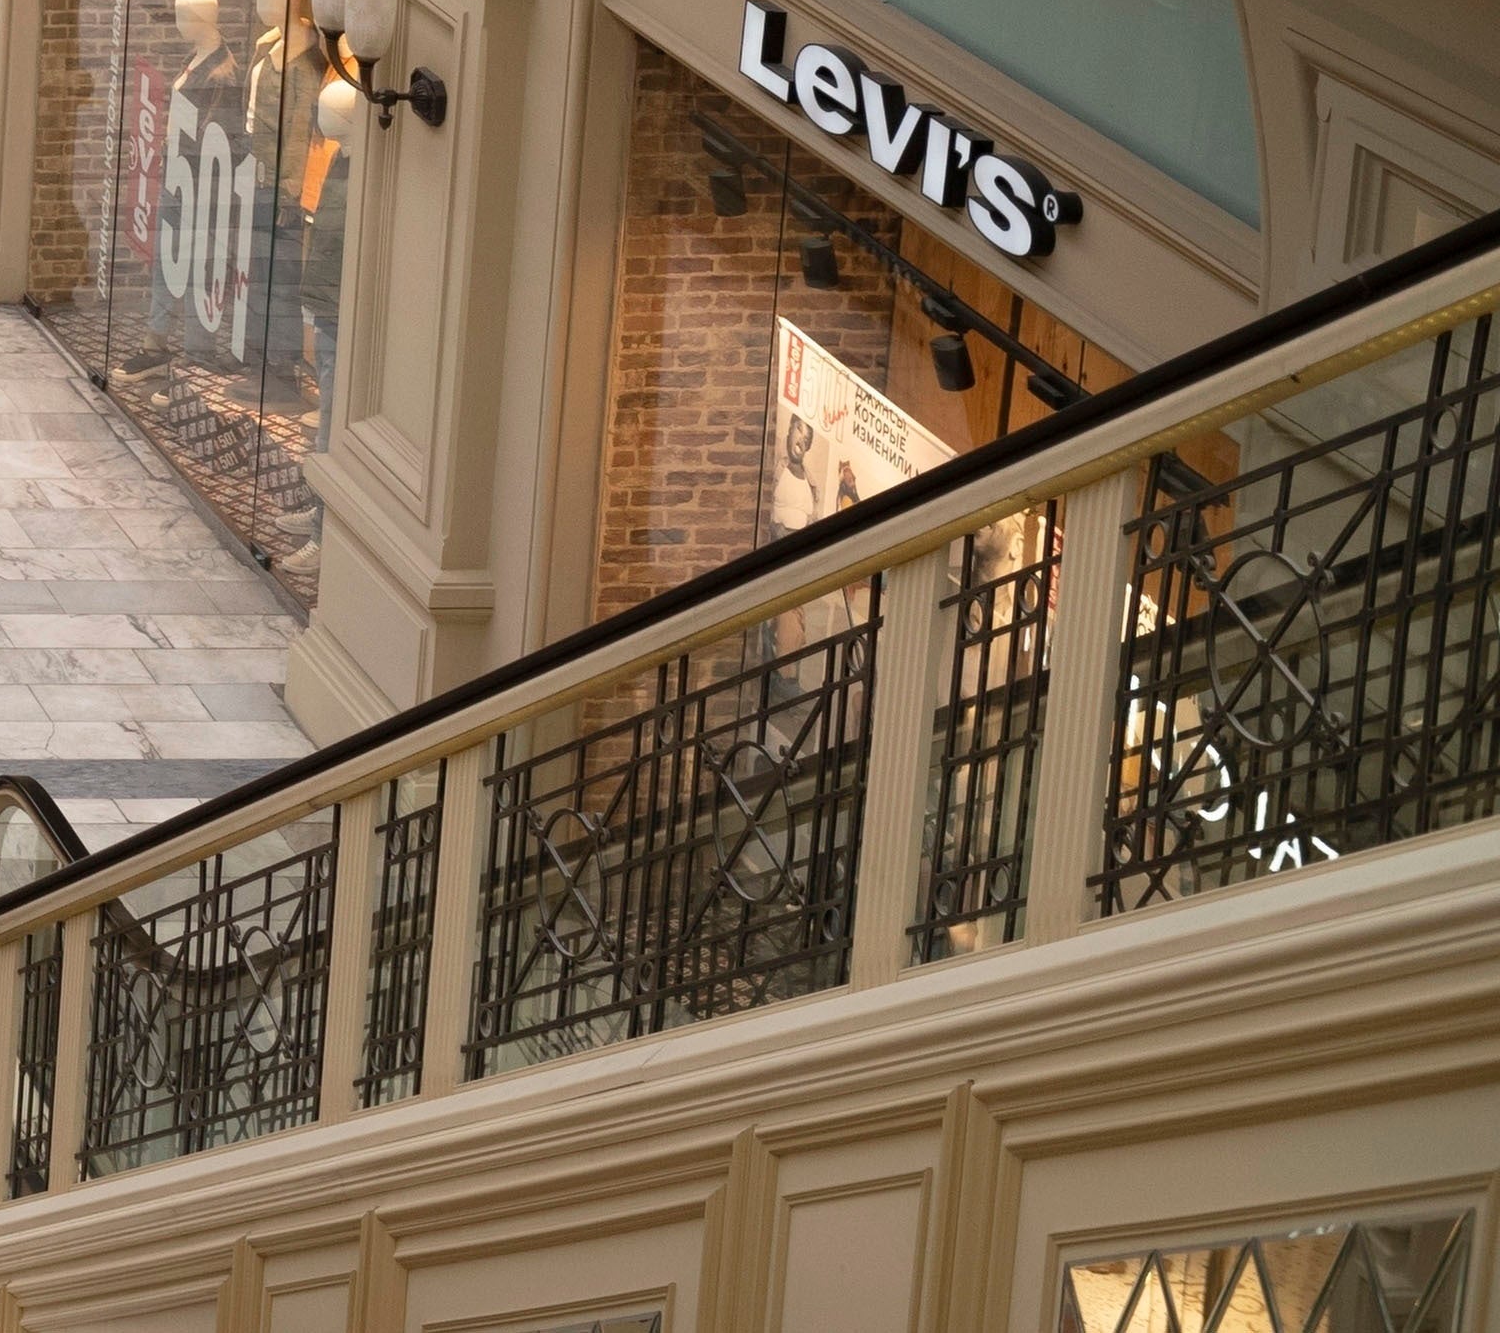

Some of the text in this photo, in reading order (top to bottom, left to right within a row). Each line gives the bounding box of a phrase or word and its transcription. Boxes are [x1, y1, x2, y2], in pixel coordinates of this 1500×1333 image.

[160, 86, 258, 364] 501
[852, 421, 912, 478] ИЗМЕНИЛИ
[854, 401, 907, 454] КОТОРЫЕ
